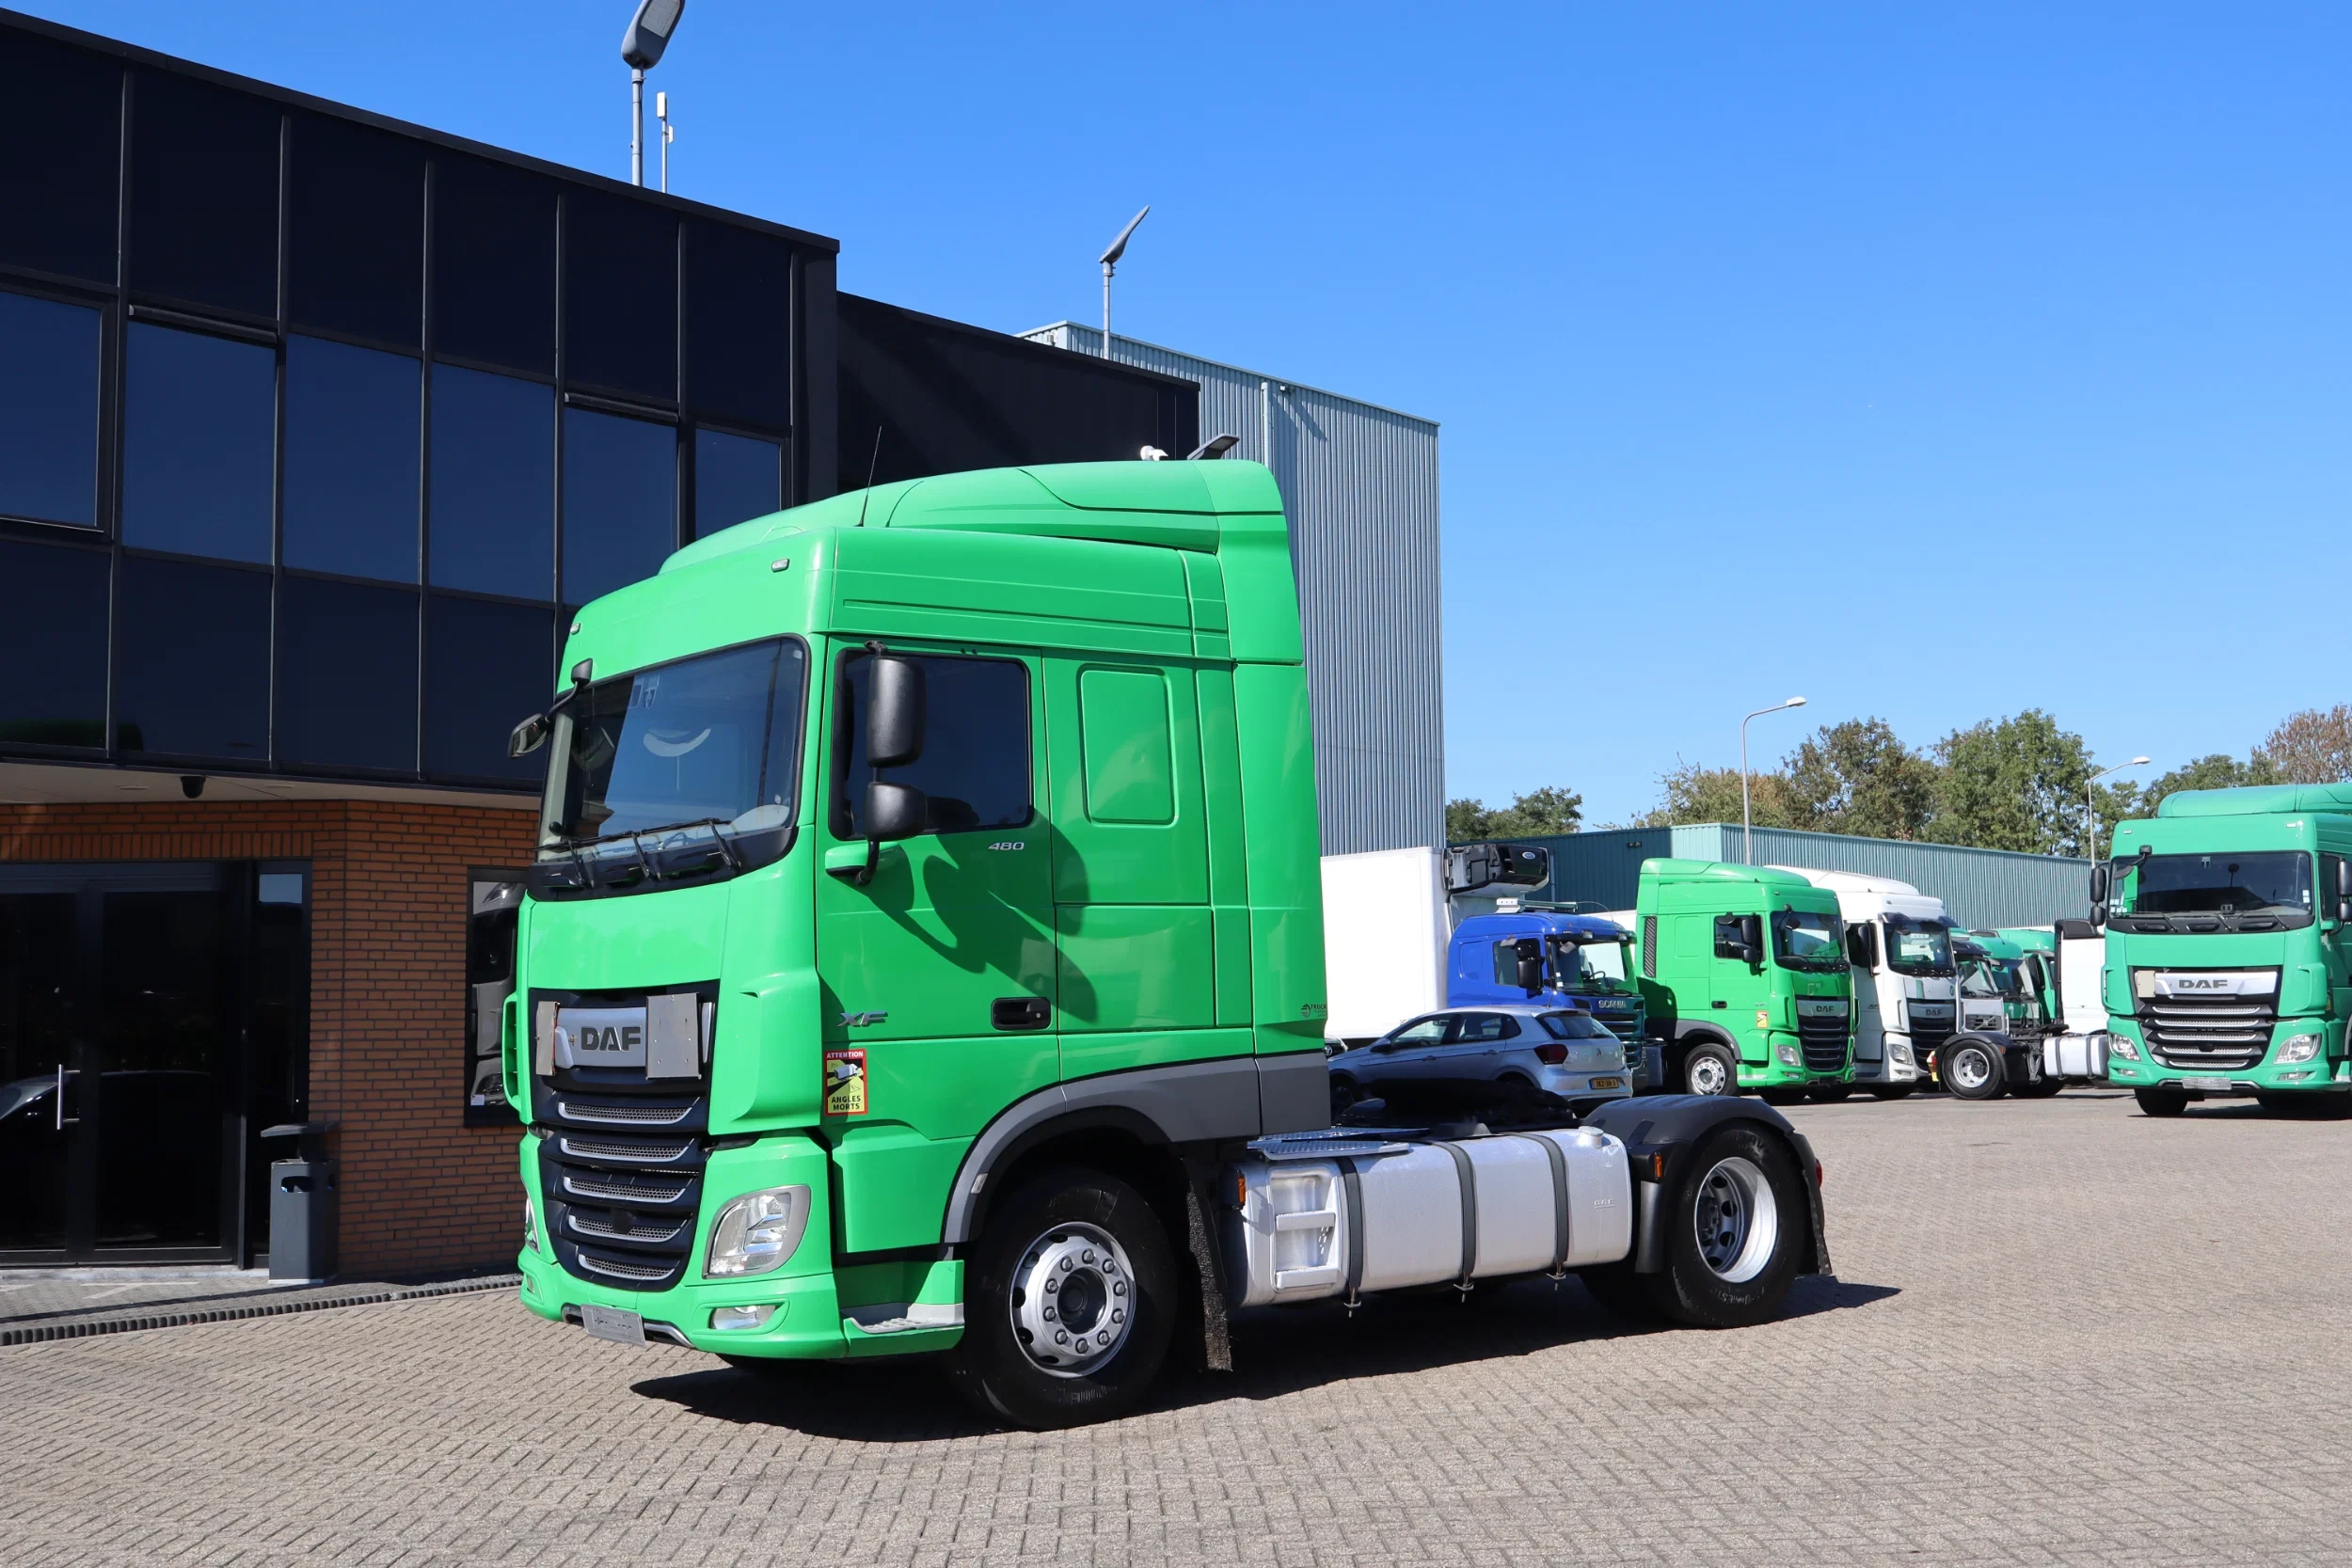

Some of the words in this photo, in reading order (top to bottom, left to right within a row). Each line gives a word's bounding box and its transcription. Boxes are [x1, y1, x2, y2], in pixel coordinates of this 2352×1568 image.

[988, 842, 1025, 850] 480
[2179, 979, 2228, 989] DAF
[836, 1010, 889, 1027] XF
[580, 1026, 642, 1052] DAF
[832, 1095, 861, 1103] ANGLES
